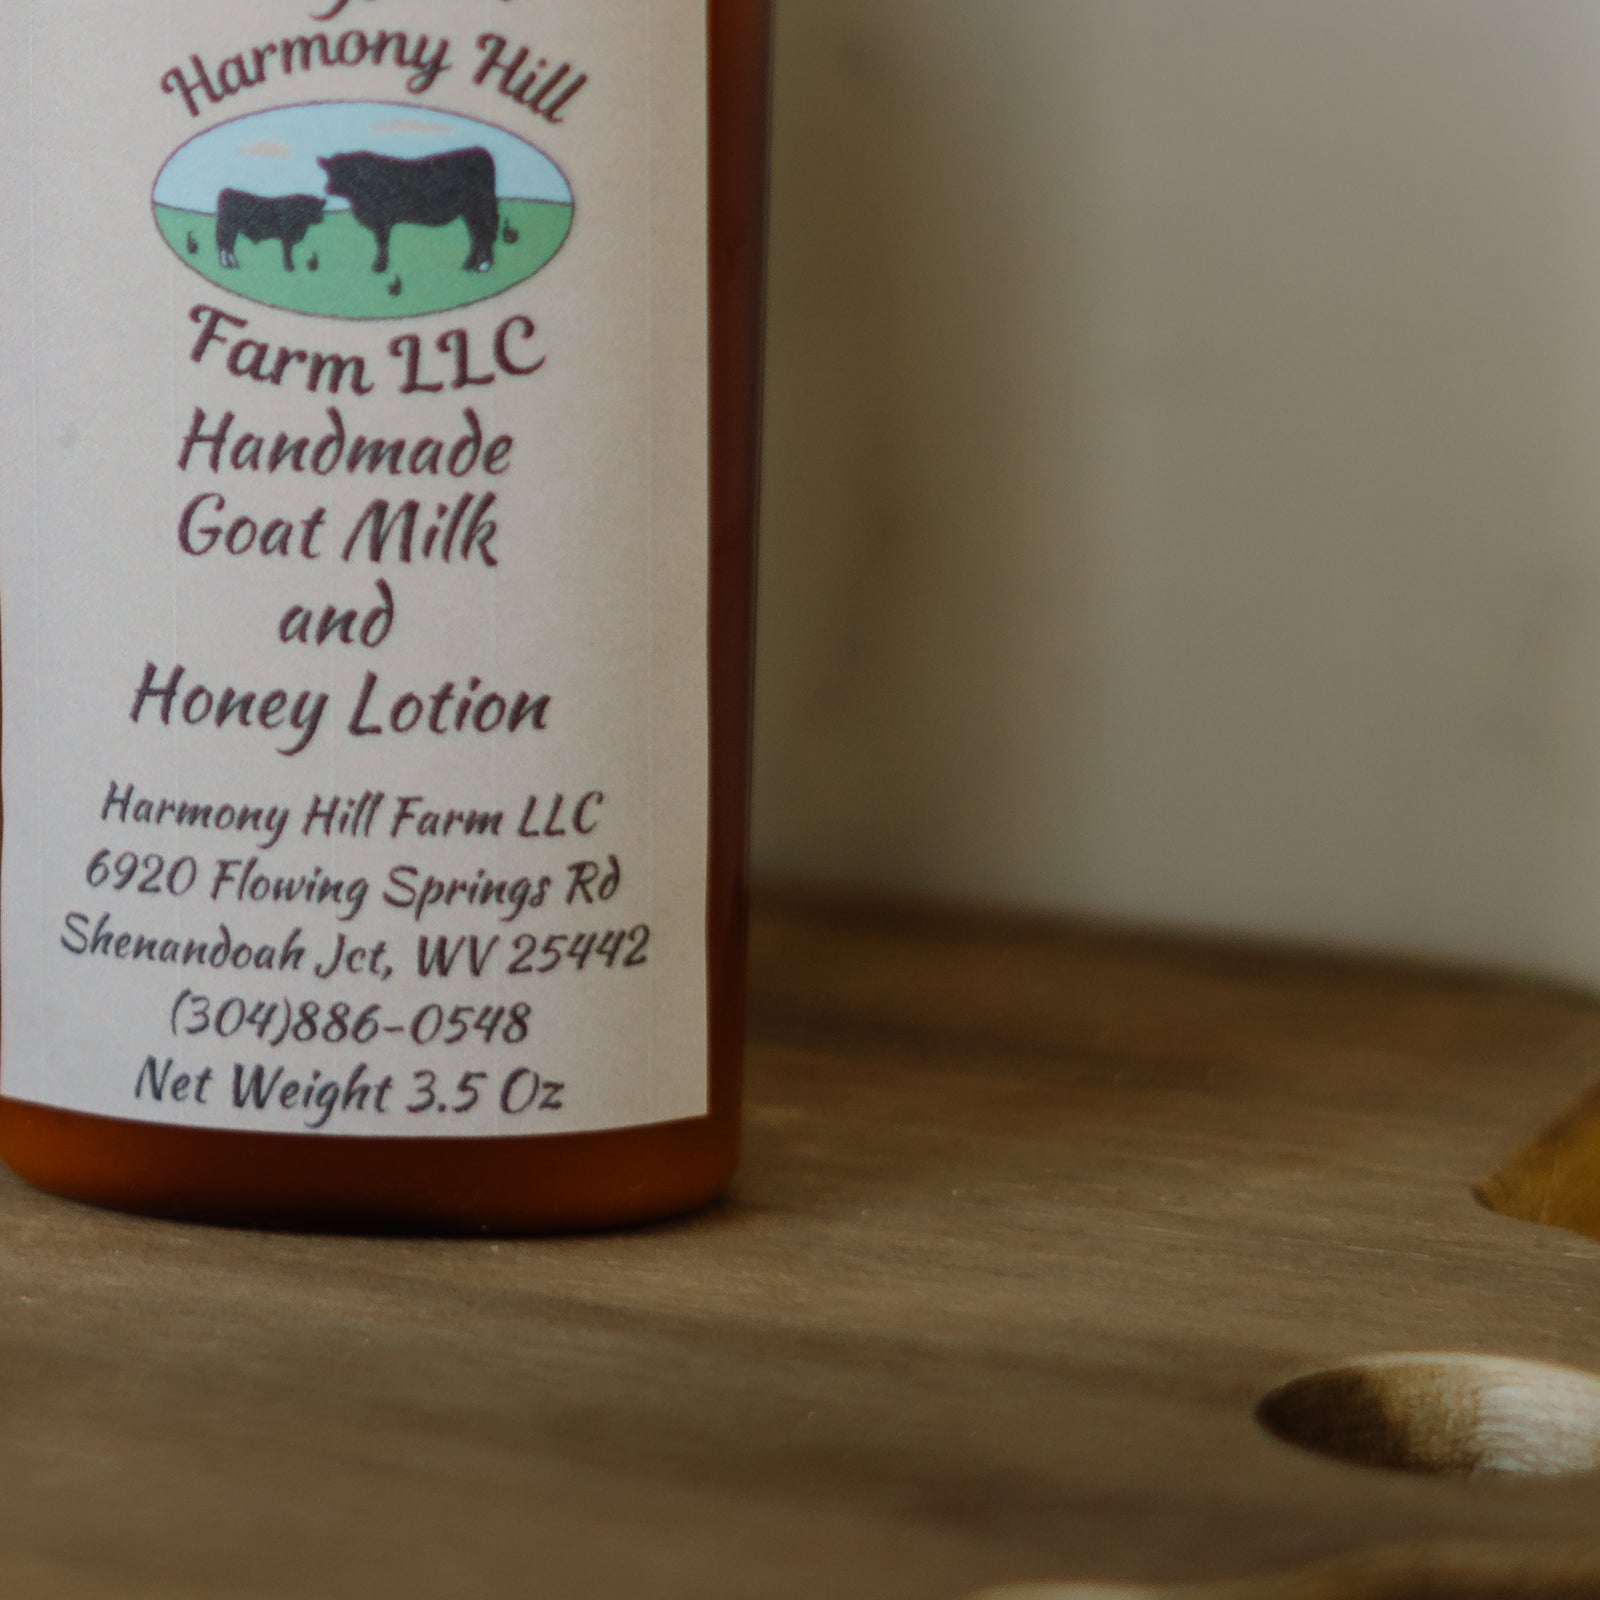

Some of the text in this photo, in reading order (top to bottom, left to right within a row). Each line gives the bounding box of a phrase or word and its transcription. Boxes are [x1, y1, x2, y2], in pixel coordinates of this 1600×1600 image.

[160, 29, 588, 125] Harmony Hill
[188, 303, 546, 397] Farm LLC
[177, 405, 514, 478] Handmade
[177, 490, 499, 568] Goat Milk
[278, 577, 395, 649] and
[128, 661, 552, 758] Honey Lotion
[100, 780, 605, 851] Harmony Hill Farm LLC
[85, 848, 622, 923] 6920 Flowing Springs Rd
[60, 911, 652, 981] Shenandoah Jct, WV 25442
[170, 987, 532, 1048] (304)886-0548
[134, 1054, 565, 1124] Net Weight 3.5 Oz
